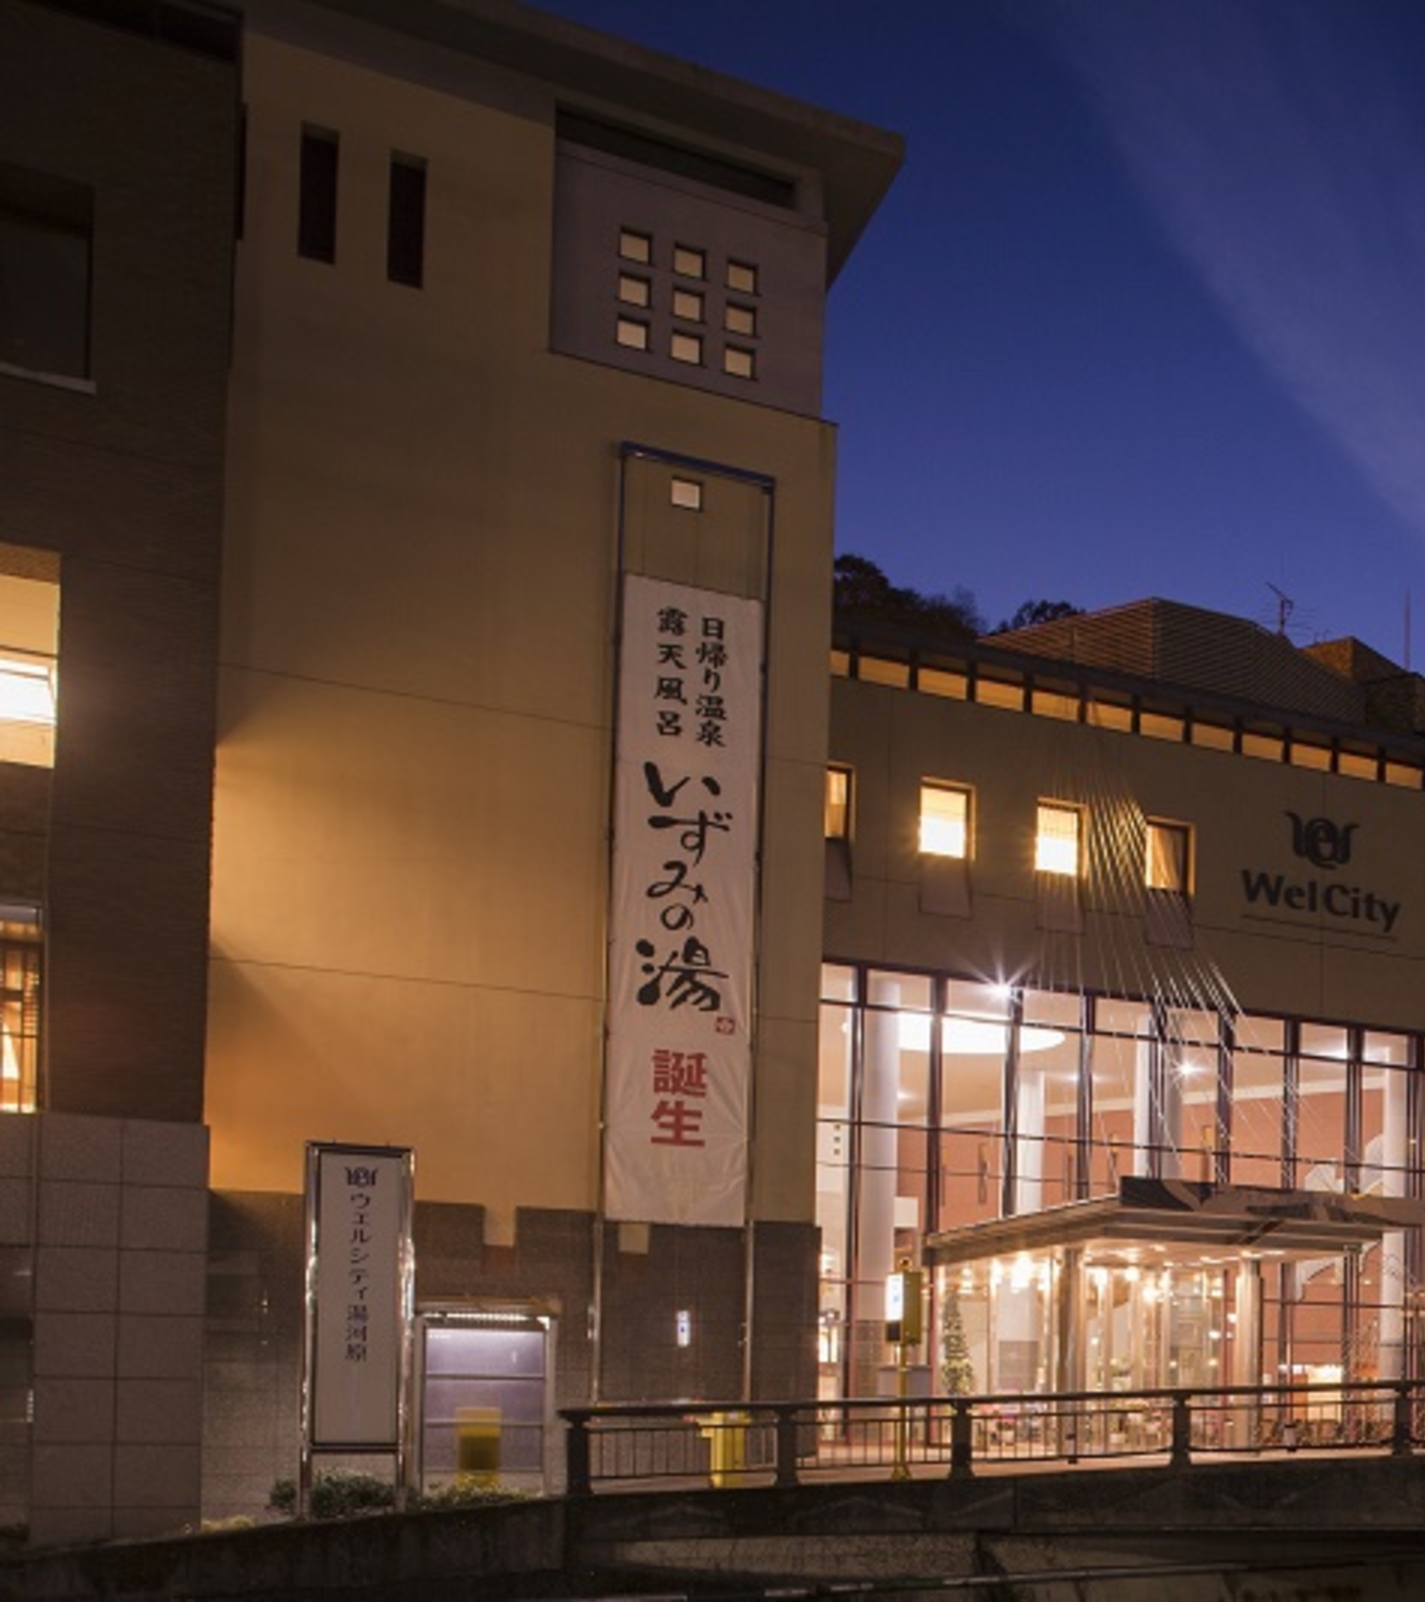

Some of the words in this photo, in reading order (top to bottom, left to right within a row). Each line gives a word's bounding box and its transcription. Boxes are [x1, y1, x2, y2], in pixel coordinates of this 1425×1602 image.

[654, 606, 688, 737] 露天風呂
[696, 616, 728, 747] 日帰り温泉
[635, 761, 733, 1012] いずみの湯
[650, 1049, 707, 1148] 誕生
